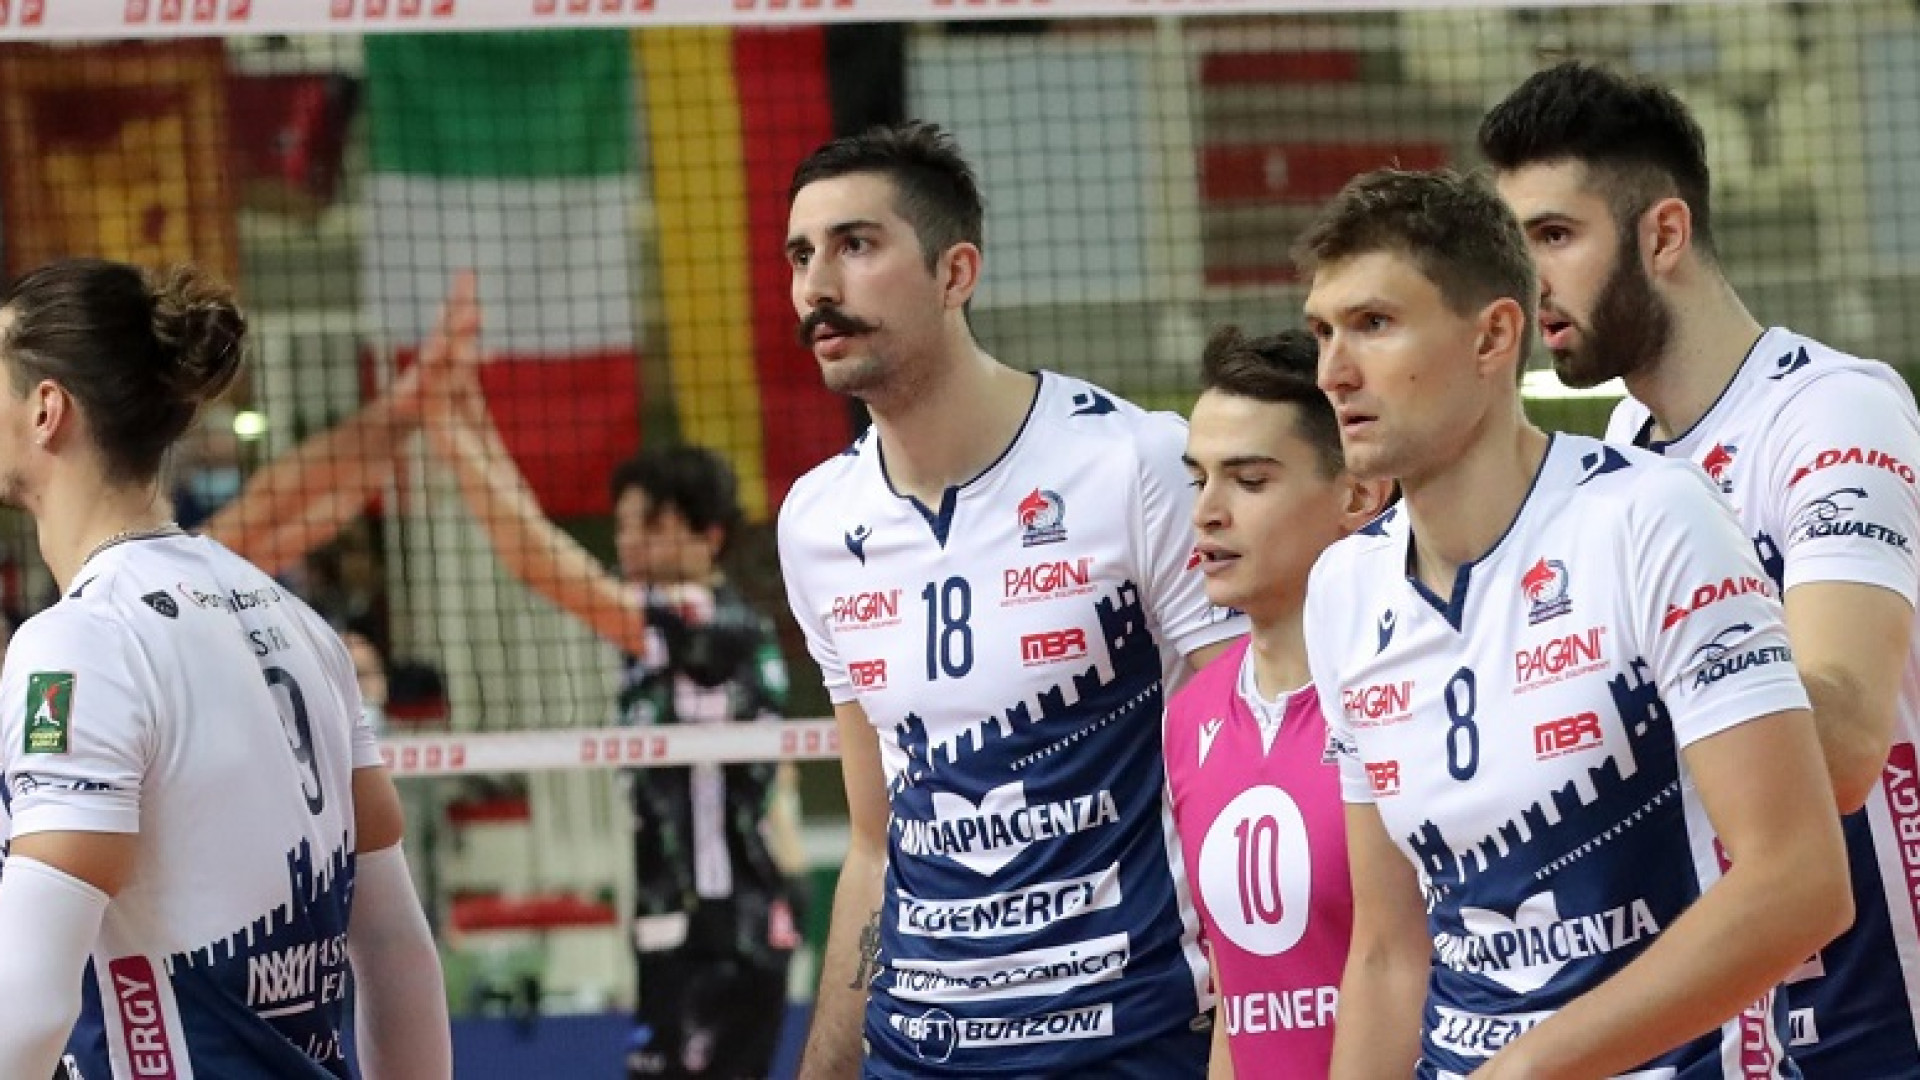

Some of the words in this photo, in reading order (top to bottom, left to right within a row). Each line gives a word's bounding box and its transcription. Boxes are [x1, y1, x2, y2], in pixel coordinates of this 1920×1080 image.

[1004, 561, 1089, 598] PAGANI
[920, 575, 975, 681] 18
[1020, 628, 1087, 661] MBR
[1515, 627, 1603, 684] PAGANI
[260, 666, 326, 816] 9
[1443, 665, 1481, 781] 8
[1534, 710, 1605, 755] MBR
[1233, 815, 1284, 926] 10
